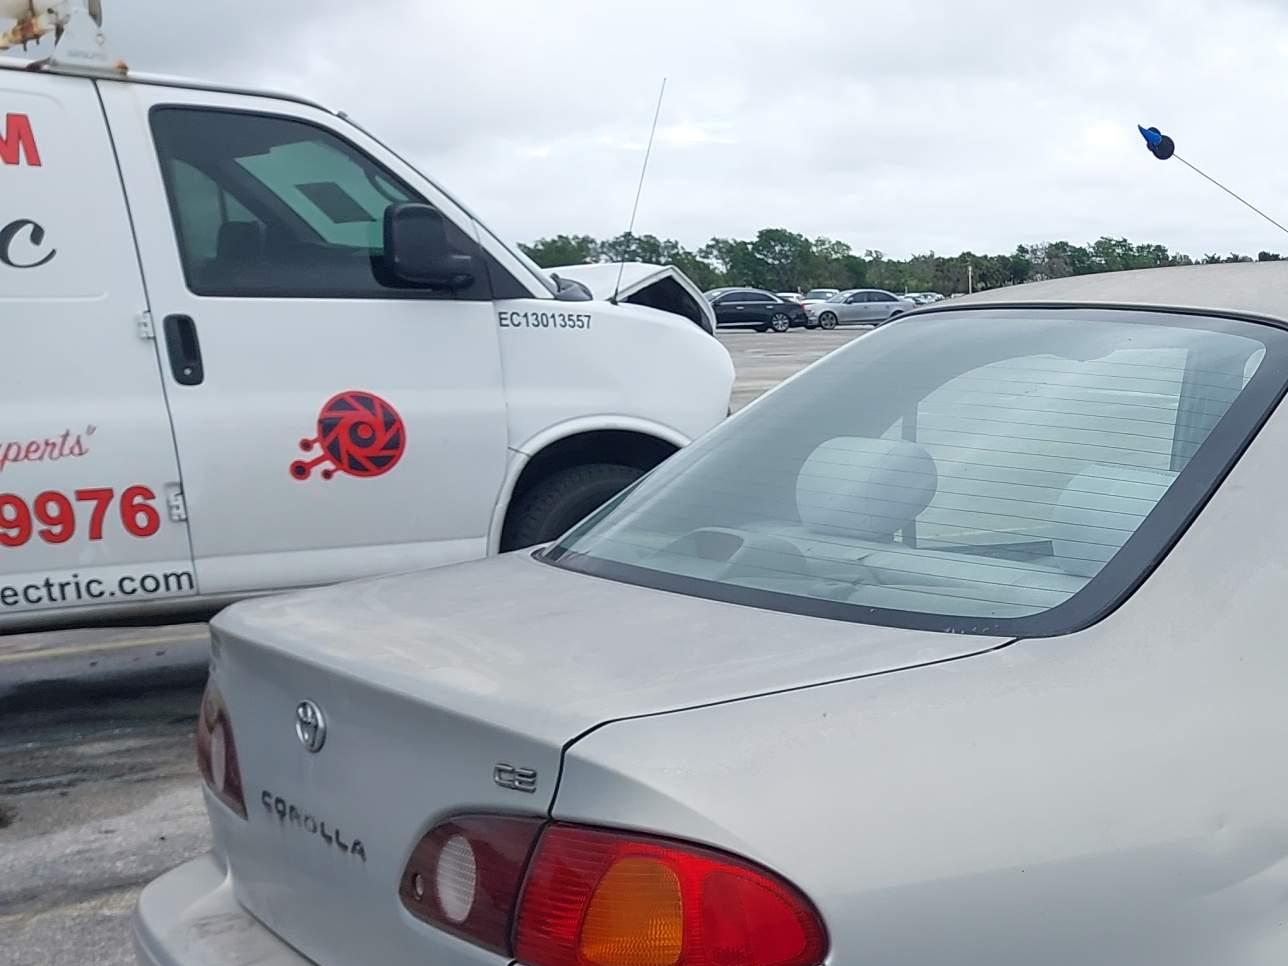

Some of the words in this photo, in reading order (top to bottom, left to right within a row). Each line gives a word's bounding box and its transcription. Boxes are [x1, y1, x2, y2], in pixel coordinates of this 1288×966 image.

[498, 311, 591, 329] EC13013557
[0, 424, 96, 472] perts"
[0, 484, 161, 548] 9976
[0, 570, 195, 607] ectric.com
[493, 763, 537, 793] CE
[261, 790, 367, 863] COROLLA
